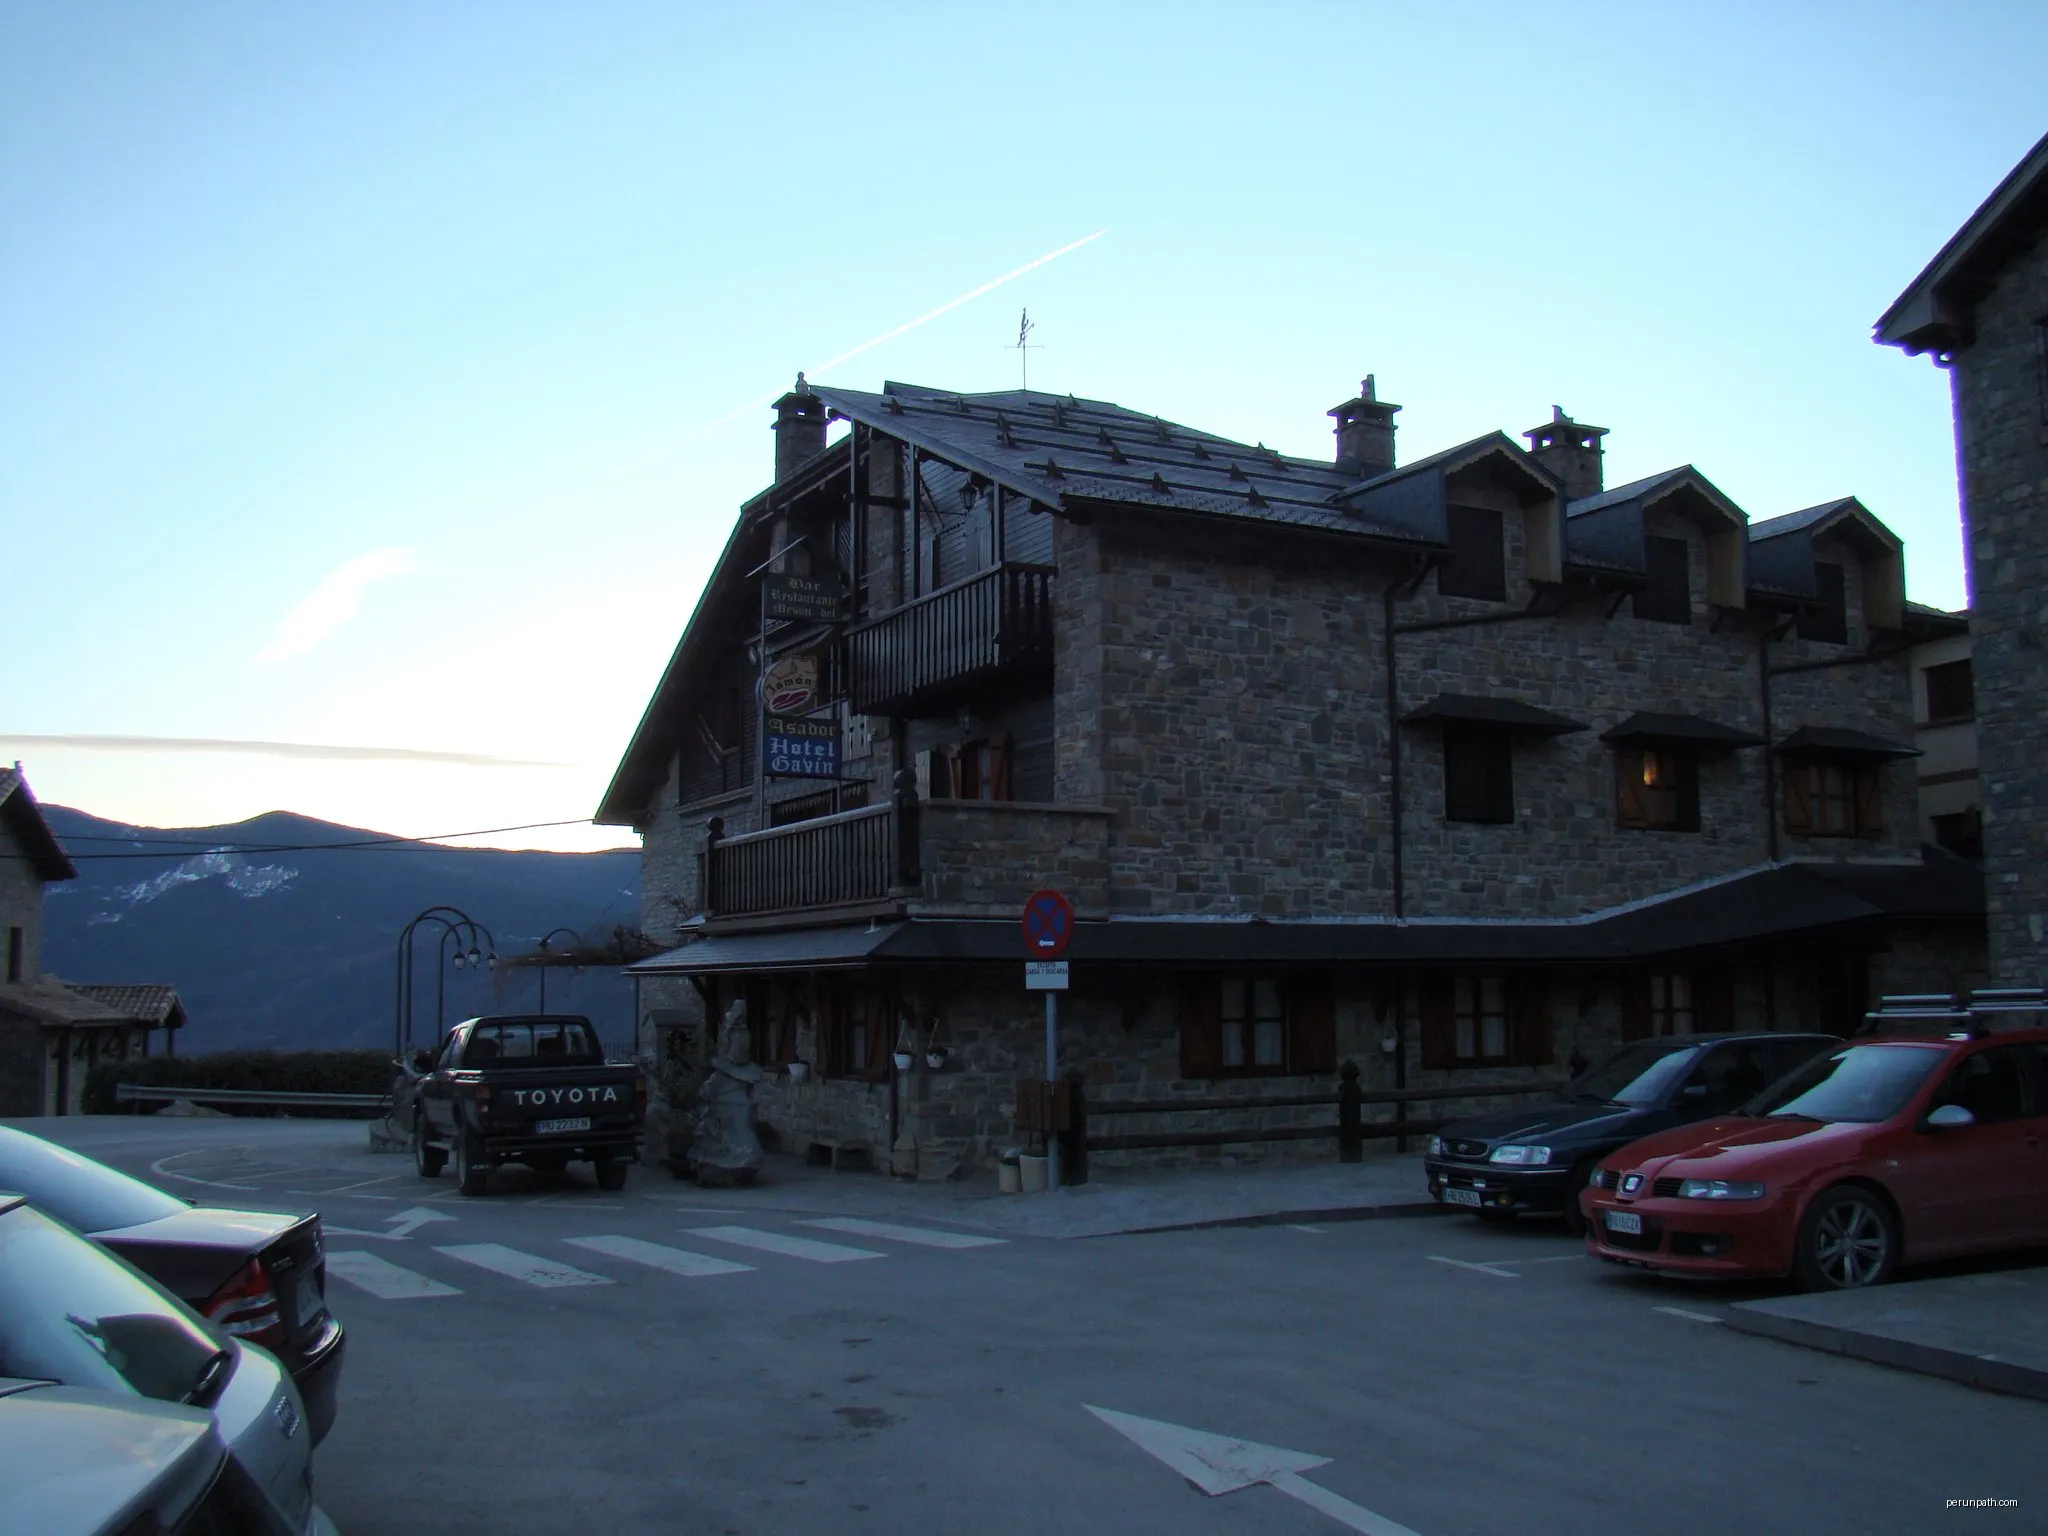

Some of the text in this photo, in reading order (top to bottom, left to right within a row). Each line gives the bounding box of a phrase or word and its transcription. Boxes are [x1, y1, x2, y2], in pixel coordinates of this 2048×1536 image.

[788, 577, 821, 592] Bar
[770, 588, 837, 606] Restaurante
[768, 718, 836, 737] Asador
[769, 737, 836, 758] Hotel
[772, 755, 834, 774] Gavín
[514, 1087, 617, 1106] TOYOTA
